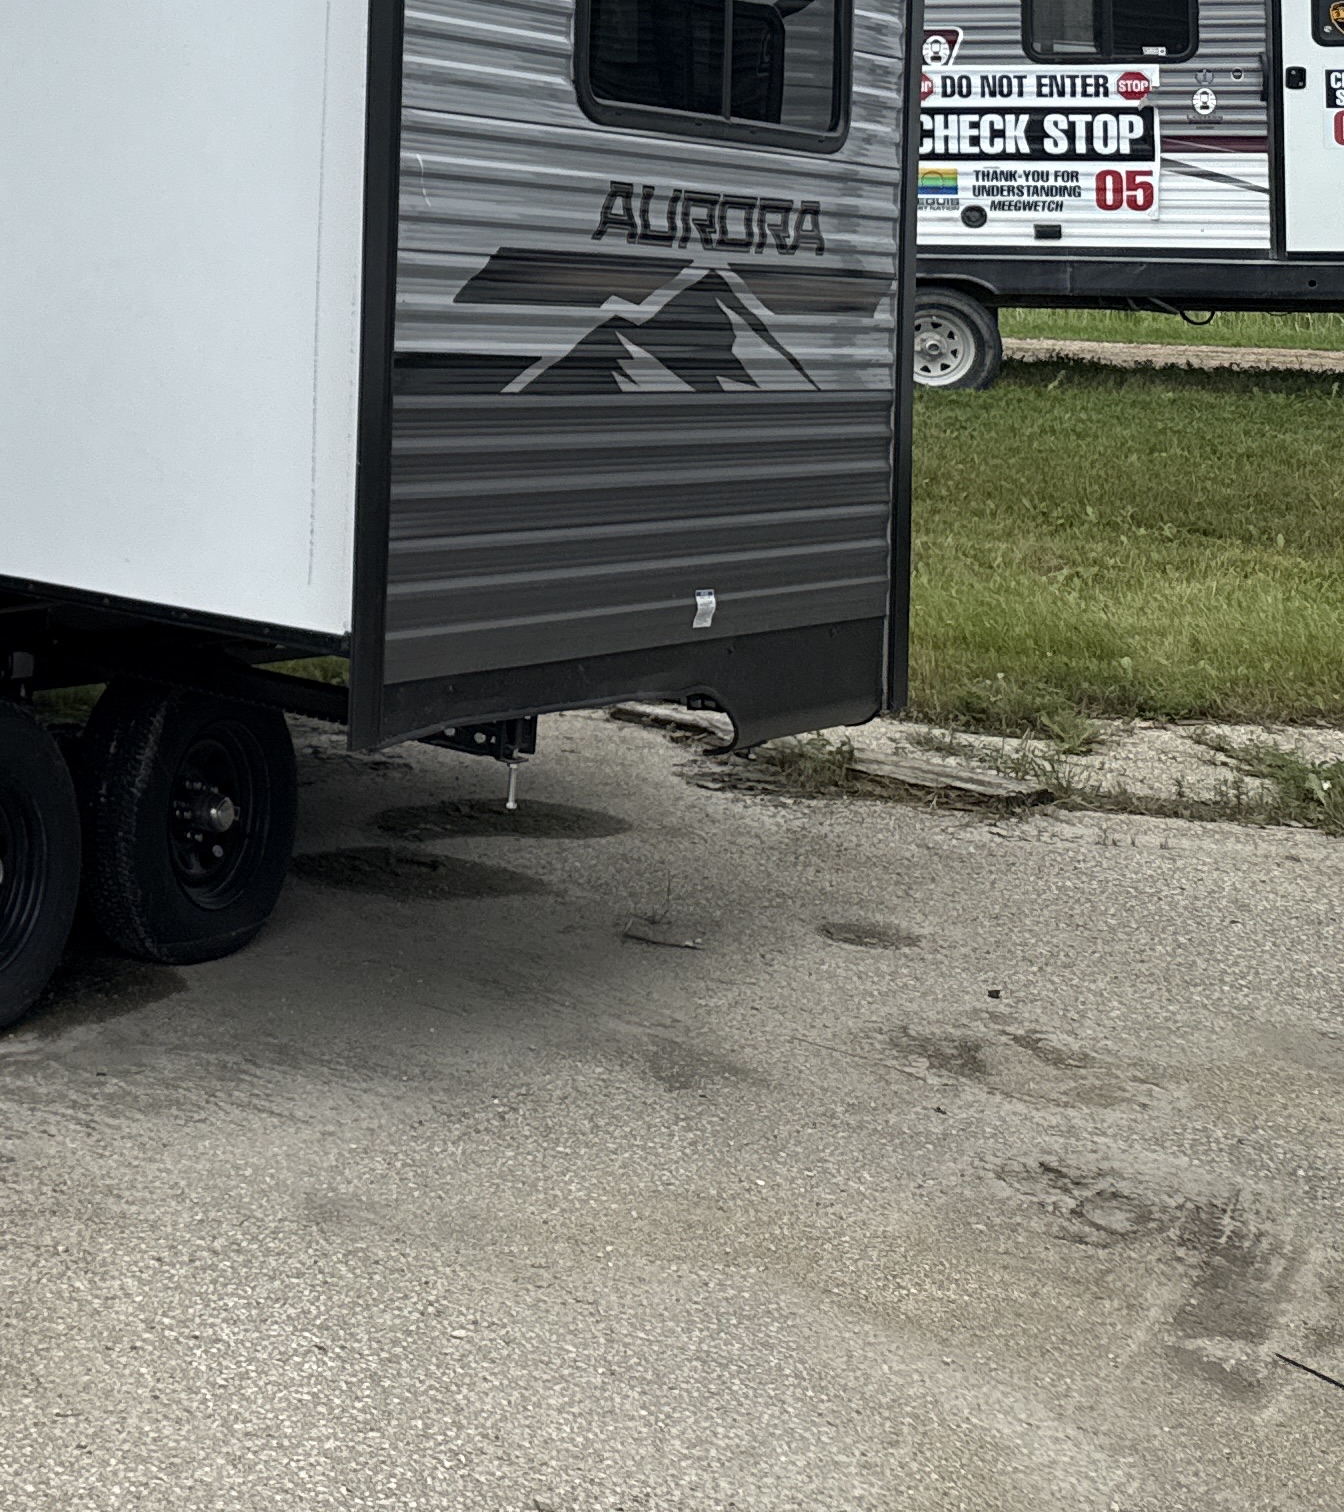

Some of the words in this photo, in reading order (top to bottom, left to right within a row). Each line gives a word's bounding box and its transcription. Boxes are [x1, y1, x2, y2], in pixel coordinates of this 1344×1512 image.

[941, 75, 972, 98] DO
[980, 75, 1027, 98] NOT
[1035, 75, 1109, 98] ENTER
[1118, 80, 1149, 93] STOP
[919, 114, 1031, 155] CHECK
[1043, 114, 1144, 155] STOP
[973, 170, 1050, 183] THANK-YOU
[1054, 170, 1079, 183] FOR
[972, 185, 1082, 198] UNDERSTANDING
[1095, 169, 1154, 211] 05
[990, 200, 1064, 212] MEEGWETCH
[591, 180, 825, 256] AURORA
